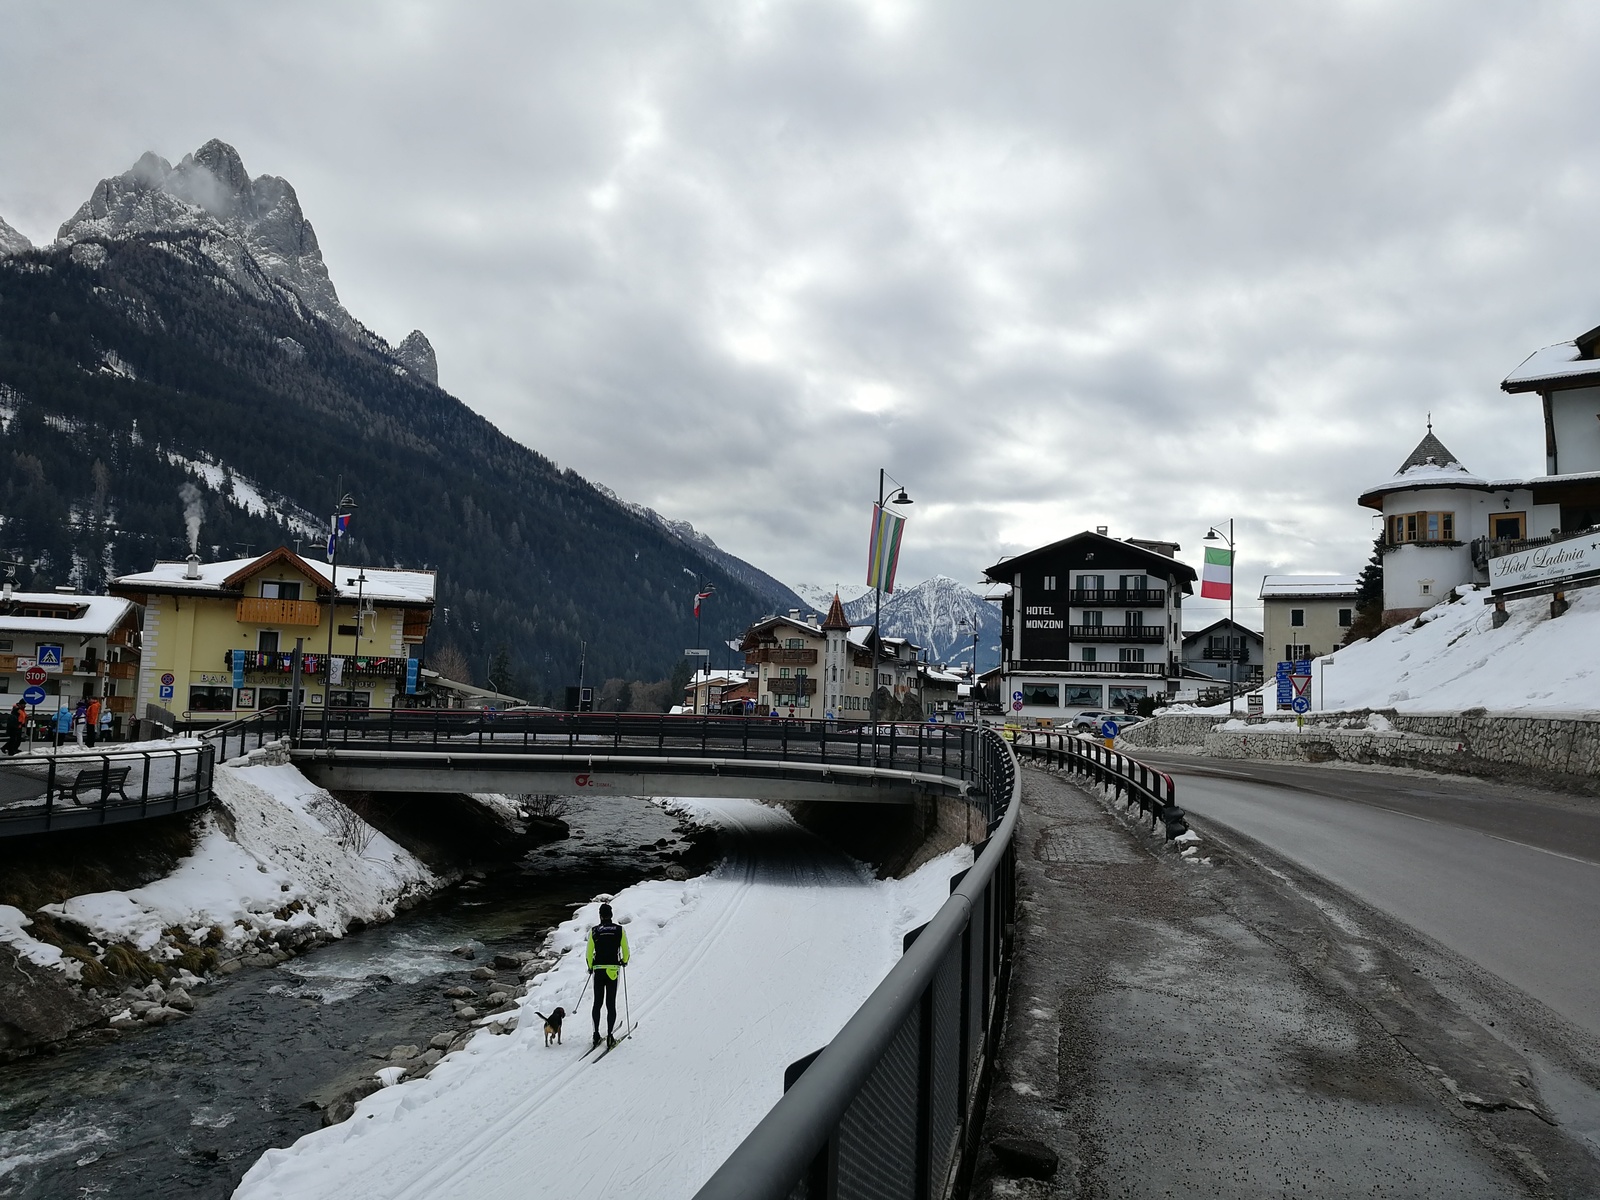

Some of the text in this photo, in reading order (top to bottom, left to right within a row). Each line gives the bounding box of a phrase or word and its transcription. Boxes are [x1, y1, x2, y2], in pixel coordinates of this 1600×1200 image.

[1495, 547, 1585, 577] Hotel Ladinia
[1026, 606, 1055, 615] HOTEL
[1026, 620, 1064, 629] MONZONI
[26, 672, 46, 680] STOP
[201, 674, 228, 683] BAR
[162, 686, 172, 697] P
